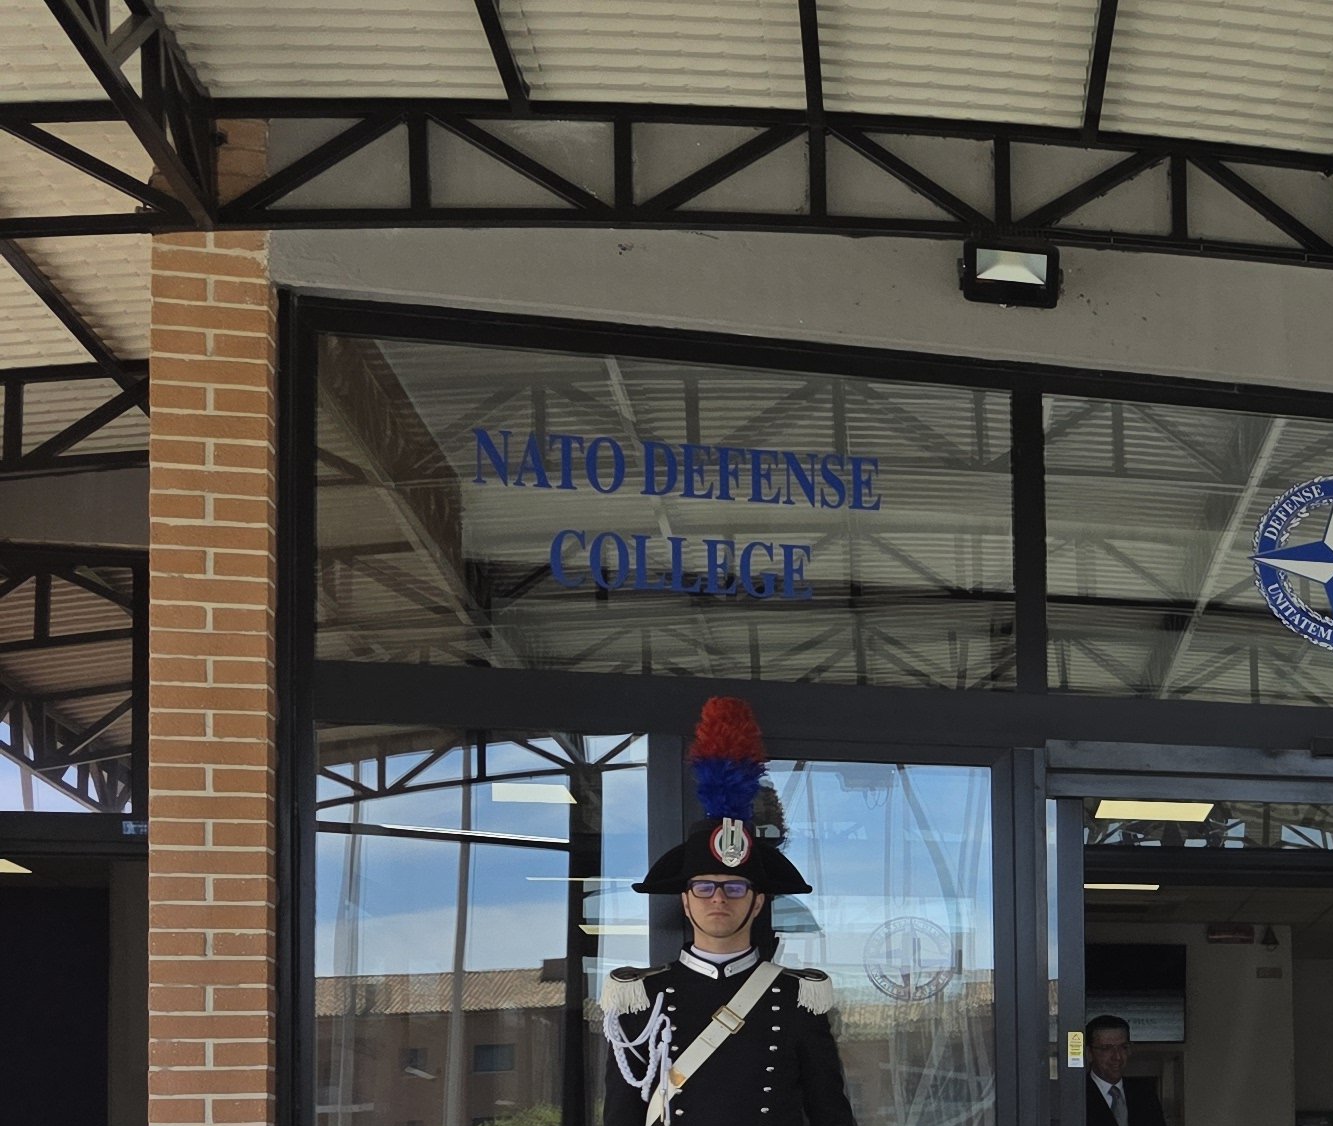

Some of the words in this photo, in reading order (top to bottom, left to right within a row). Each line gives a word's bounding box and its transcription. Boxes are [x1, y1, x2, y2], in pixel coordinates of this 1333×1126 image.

[472, 427, 626, 494] NATO
[640, 439, 882, 511] DEFENSE
[1263, 484, 1325, 541] DEFENSE
[549, 529, 813, 600] COLLEGE
[1267, 583, 1332, 641] UNITATEM
